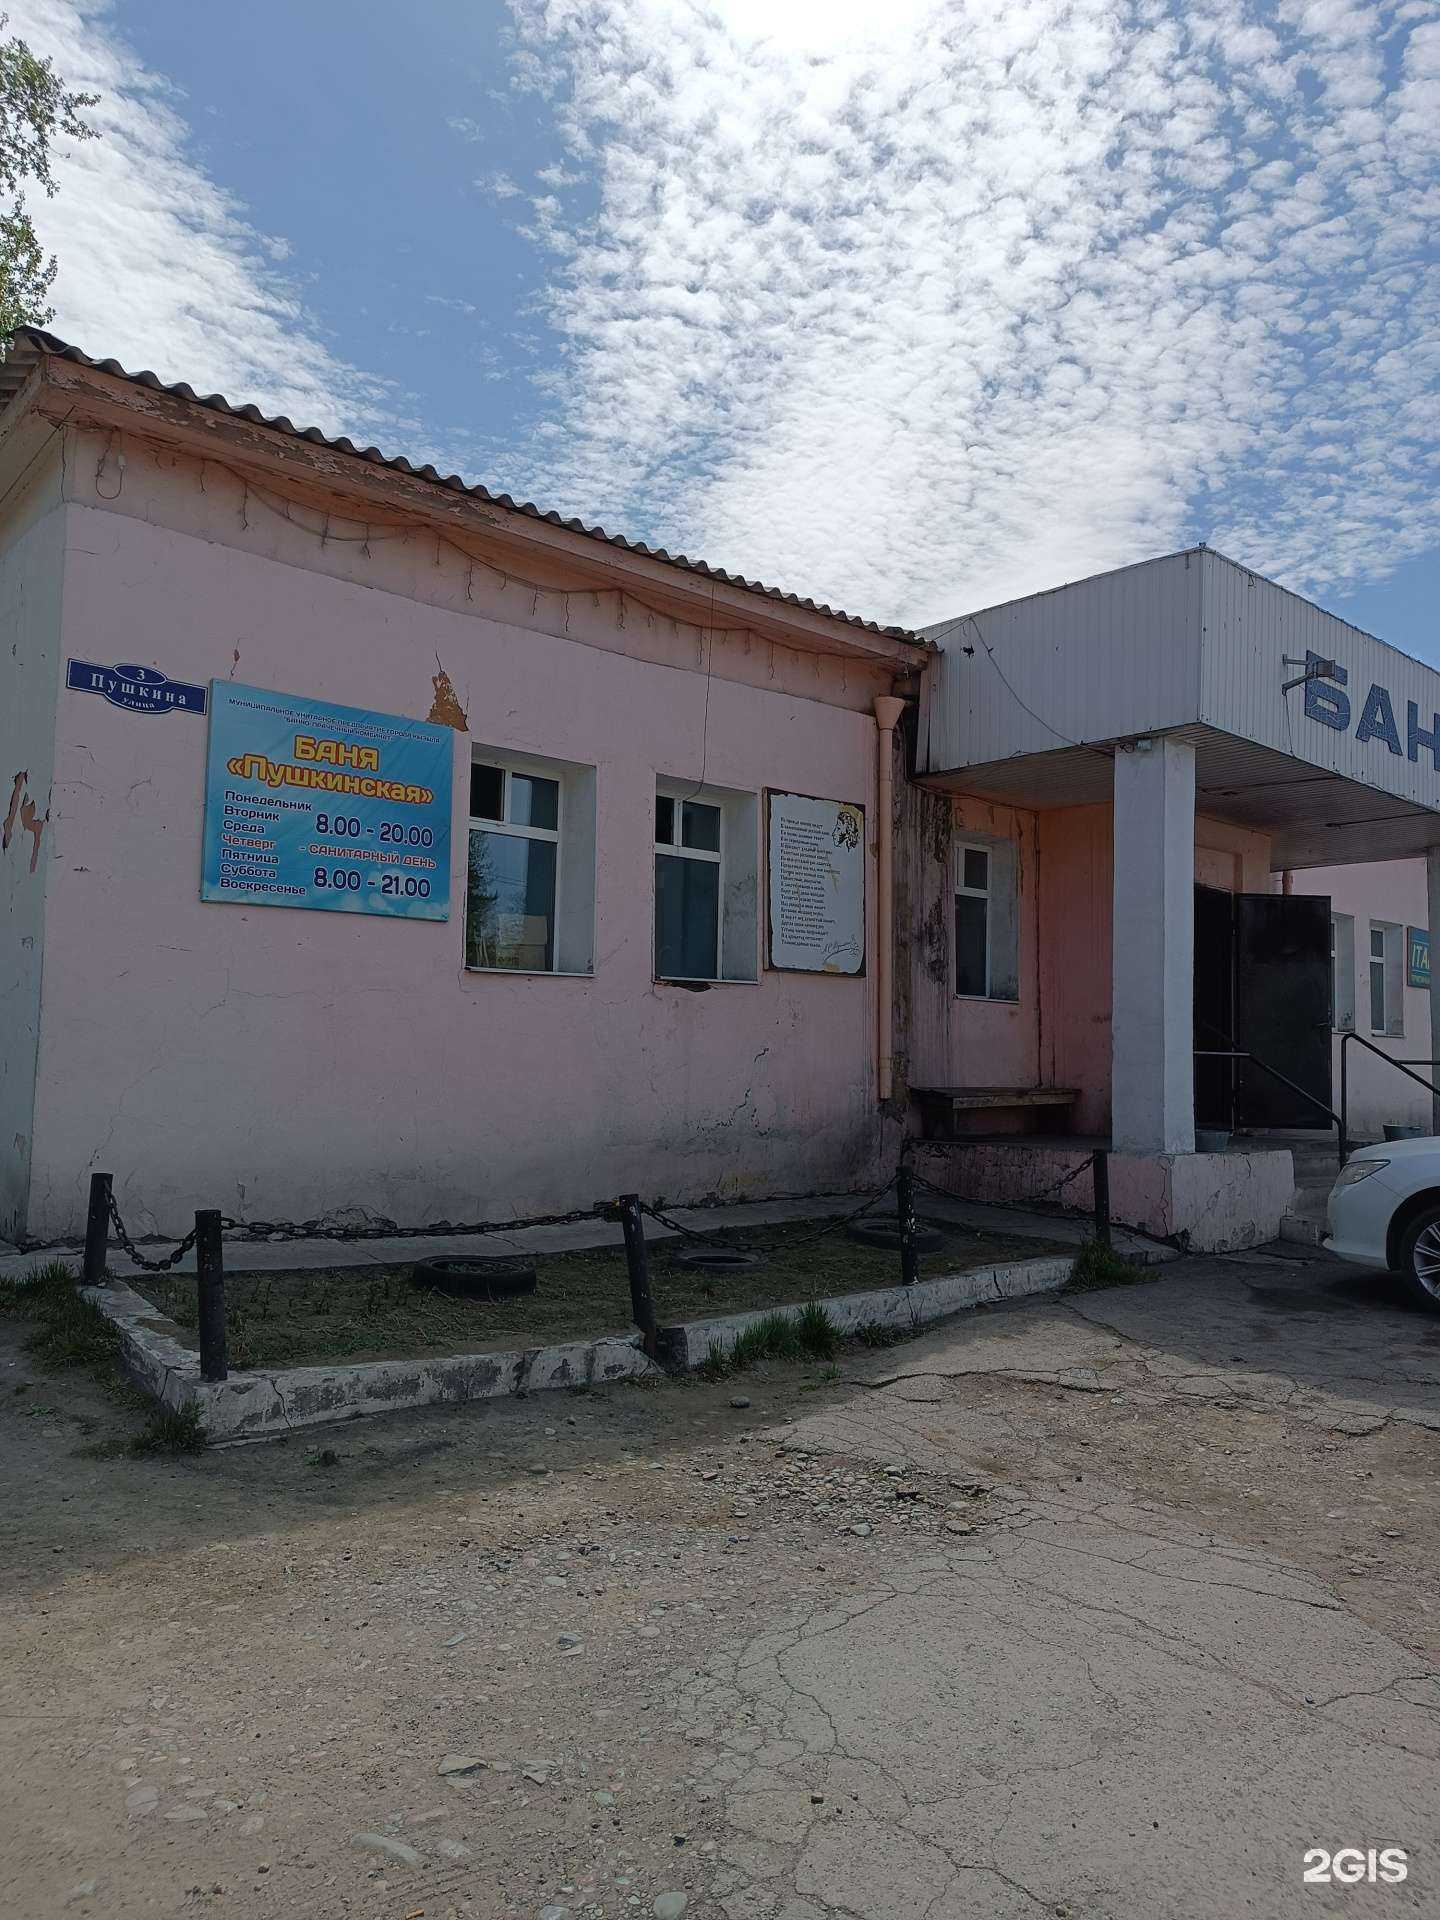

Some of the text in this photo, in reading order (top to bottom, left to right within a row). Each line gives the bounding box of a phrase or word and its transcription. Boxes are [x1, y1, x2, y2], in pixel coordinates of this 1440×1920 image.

[136, 669, 145, 681] 3
[90, 672, 186, 705] Пушкина
[228, 698, 294, 716] МУНИЦИПАЛЬНОЕ
[295, 711, 336, 724] УНИТАРНОЕ
[1304, 650, 1440, 773] БАН
[294, 734, 379, 772] БАНЯ
[226, 753, 434, 805] «Пушкинская»
[224, 805, 280, 822] Вторник
[225, 790, 312, 812] Понедельник
[223, 820, 265, 834] Среда
[315, 813, 361, 838] 8.00
[379, 822, 433, 847] 20.00
[222, 834, 275, 849] Четверг
[308, 844, 400, 864] САНИТАРНЫЙ
[402, 855, 437, 869] ДЕНЬ
[222, 848, 279, 864] Пятница
[221, 863, 276, 878] Суббота
[313, 866, 361, 891] 8.00
[381, 874, 431, 898] 21.00
[220, 878, 306, 896] Воскресенье
